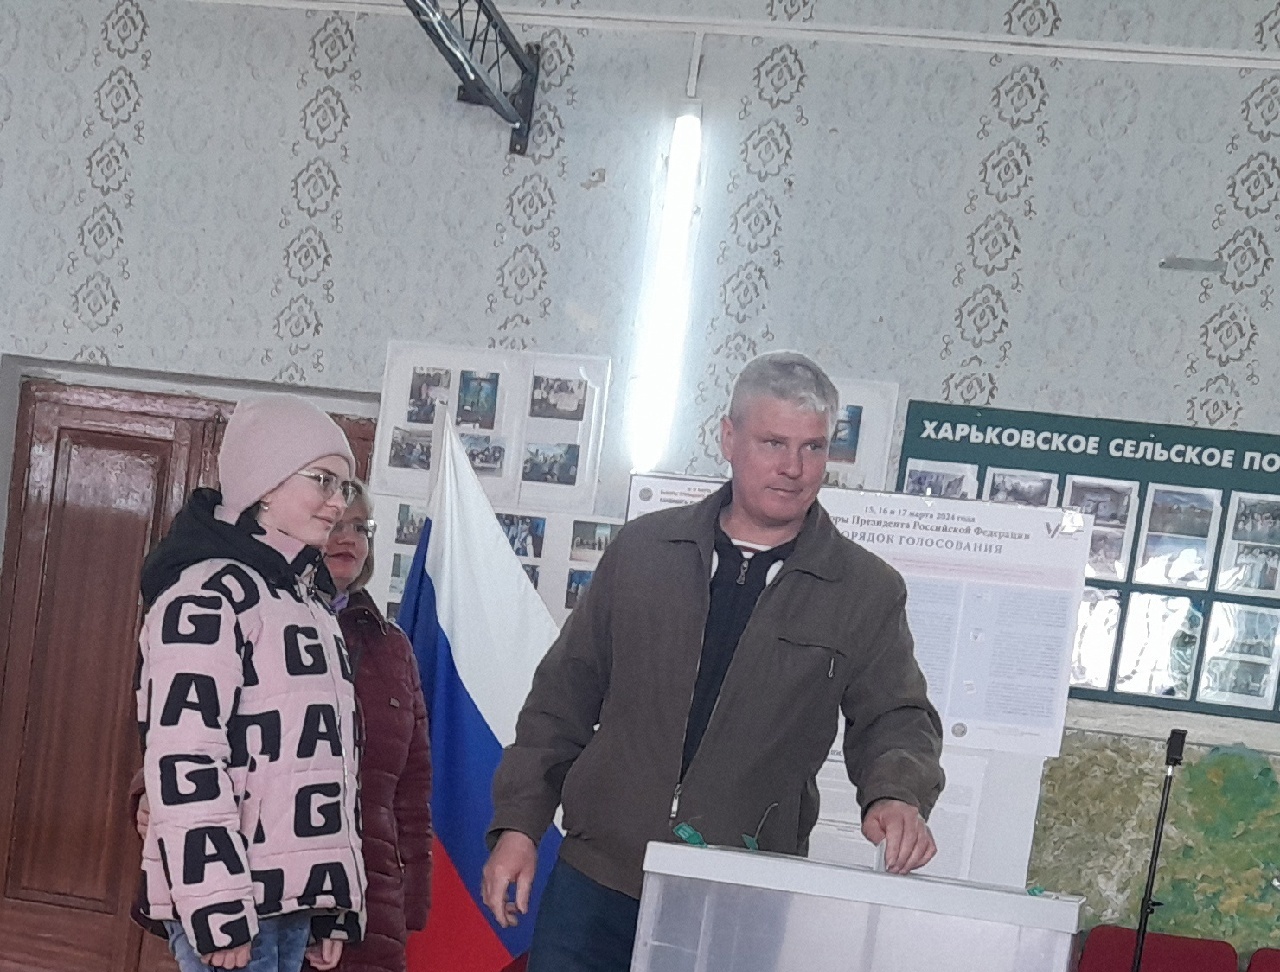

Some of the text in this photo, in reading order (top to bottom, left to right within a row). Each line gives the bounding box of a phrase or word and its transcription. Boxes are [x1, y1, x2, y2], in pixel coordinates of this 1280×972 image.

[920, 419, 1100, 455] ХАРЬКОВСКОЕ
[1109, 438, 1235, 469] СЕЛЬСКОЕ
[852, 515, 910, 529] Президента
[912, 520, 971, 534] Российской
[841, 531, 1003, 554] ОРЯДОК ГОЛОСОВАНИЯ
